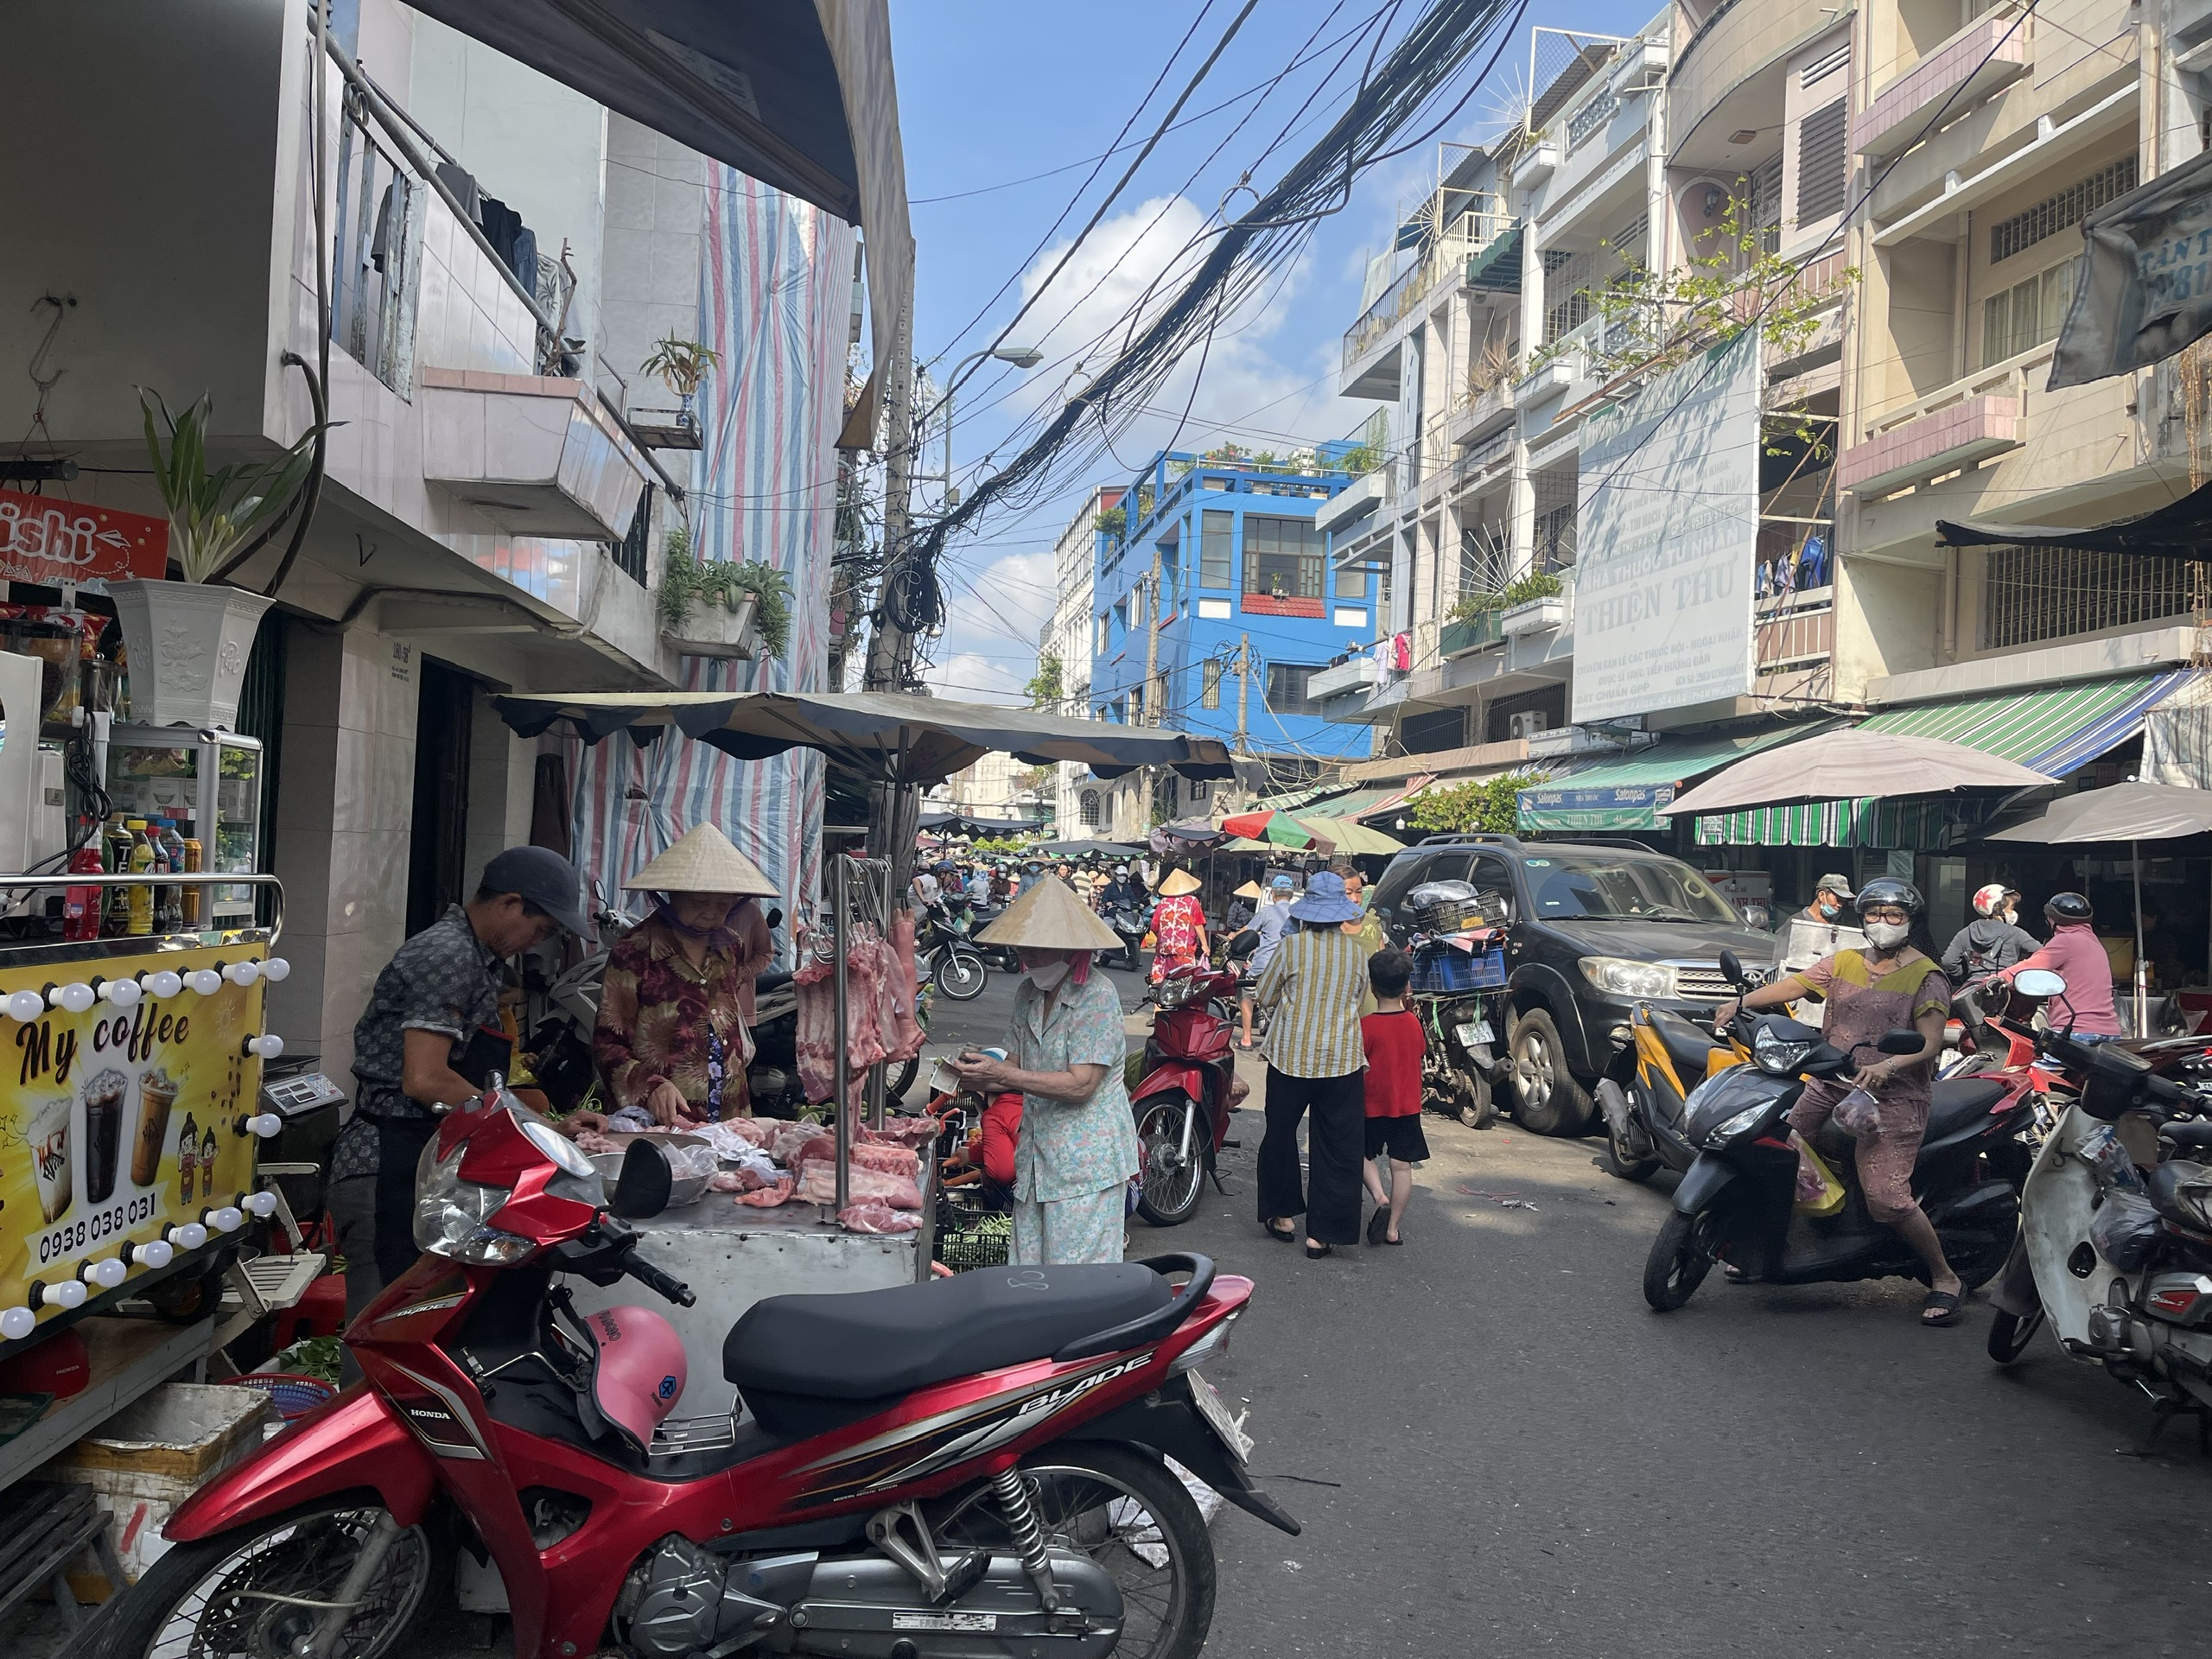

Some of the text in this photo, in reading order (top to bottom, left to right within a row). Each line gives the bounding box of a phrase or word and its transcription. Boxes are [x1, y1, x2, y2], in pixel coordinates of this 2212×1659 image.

[1637, 534, 1647, 547] P.4
[1670, 522, 1681, 535] GP
[1613, 551, 1662, 582] THUỐC
[1666, 543, 1688, 565] TƯ
[1691, 525, 1738, 556] NHÂN
[1582, 556, 1739, 636] THIỆN THƯ
[1576, 659, 1602, 676] CHUYÊN
[1603, 657, 1617, 670] BÁN
[1628, 651, 1643, 664] CÁC
[1643, 645, 1669, 659] THUỐC
[1670, 641, 1684, 655] NỘI
[1690, 634, 1716, 650] NGOẠI
[1718, 627, 1742, 644] NHẬP
[1645, 660, 1662, 676] TIẾP
[1693, 651, 1710, 666] DẪN
[1576, 693, 1593, 705] ĐẠT
[1595, 685, 1628, 701] CHUẨN
[1630, 682, 1649, 695] GPP
[1536, 792, 1563, 806] Salonpas
[1614, 788, 1646, 804] Salonpas
[16, 1002, 190, 1085] My coffee
[40, 1192, 156, 1263] 0938 038 031
[397, 1302, 448, 1318] BLADE
[597, 1309, 622, 1342] PIAGGIO
[55, 1364, 79, 1376] HONDA
[1018, 1351, 1154, 1414] BLADE
[410, 1408, 451, 1420] HONDA
[833, 1483, 898, 1503] MODERN ARTISTIC EDITION
